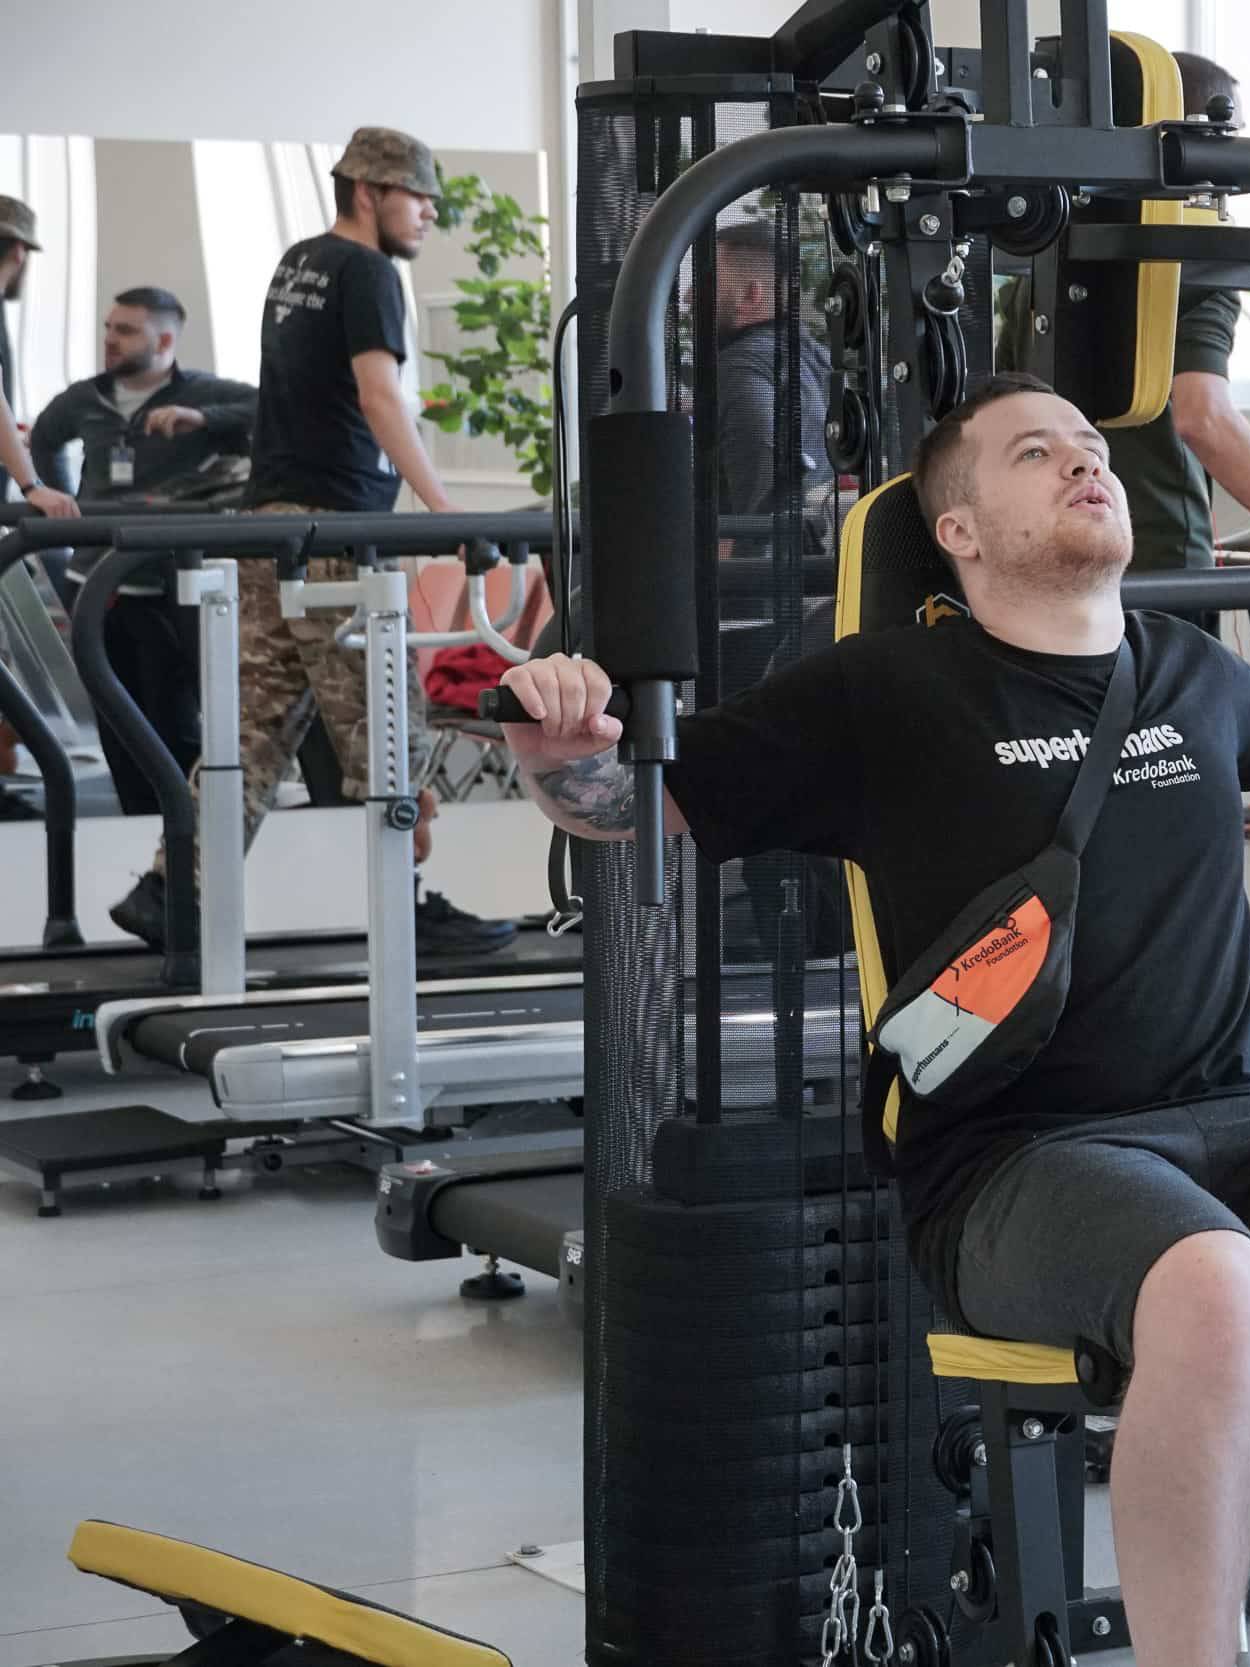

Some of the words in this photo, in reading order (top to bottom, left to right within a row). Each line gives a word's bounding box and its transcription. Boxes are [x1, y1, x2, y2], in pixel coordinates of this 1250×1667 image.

[994, 724, 1184, 768] superhmans
[1112, 754, 1197, 785] KredoBank
[1151, 772, 1201, 789] Foundation
[960, 928, 1022, 972] KredoBank
[985, 938, 1029, 967] Foundation
